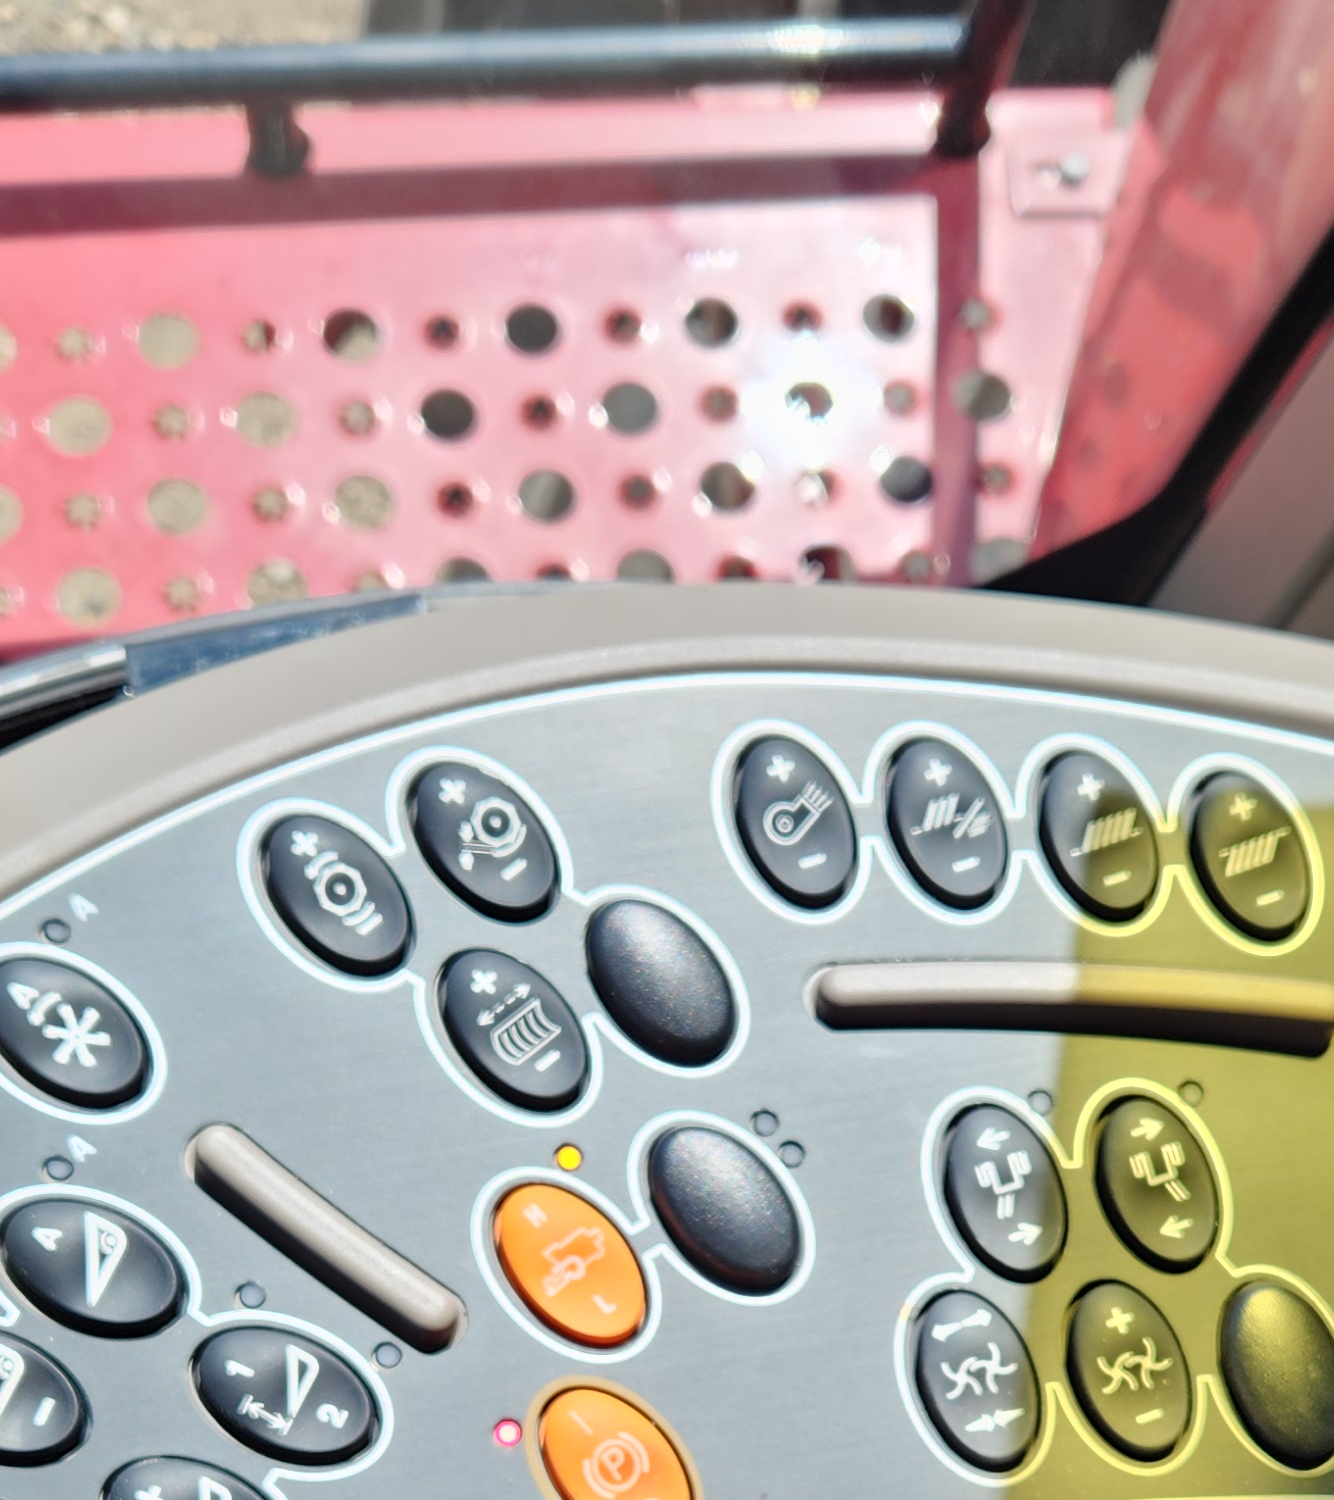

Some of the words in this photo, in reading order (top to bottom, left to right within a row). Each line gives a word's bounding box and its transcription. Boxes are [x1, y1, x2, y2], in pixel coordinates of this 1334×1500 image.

[68, 892, 99, 922] A
[6, 981, 40, 1011] A
[66, 1133, 98, 1163] A
[31, 1225, 63, 1252] A
[224, 1358, 256, 1378] 1
[315, 1402, 350, 1430] 2
